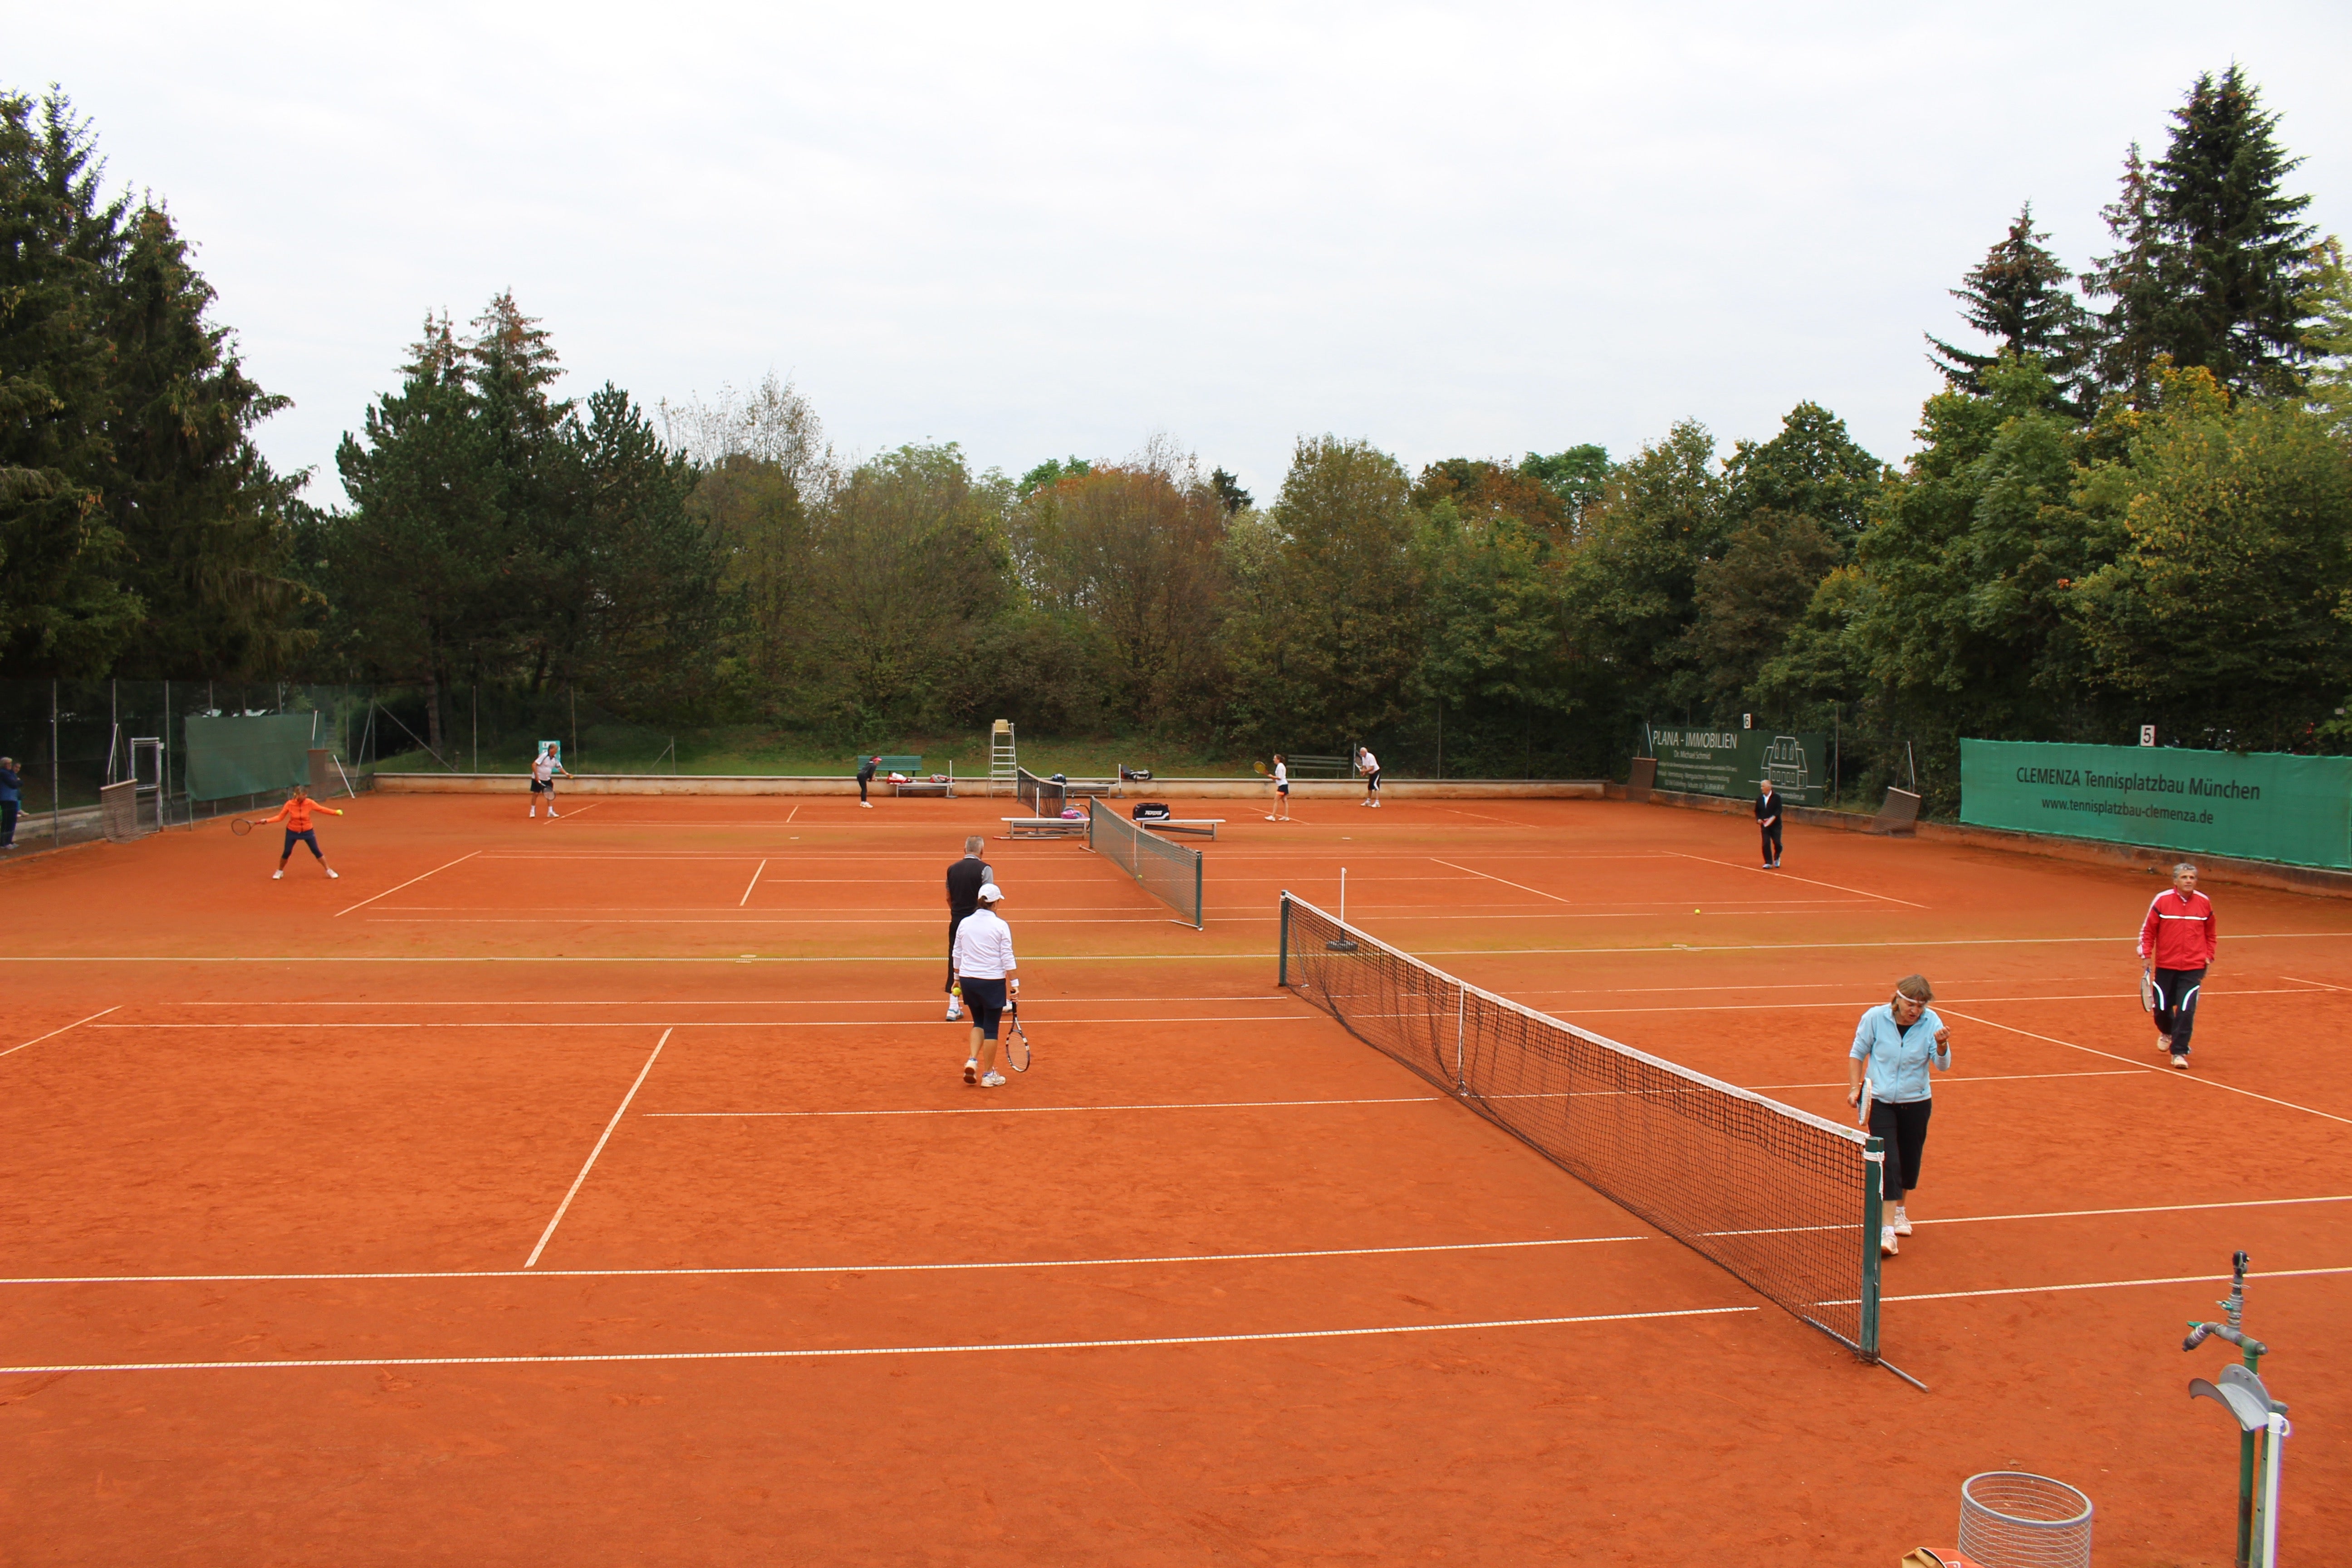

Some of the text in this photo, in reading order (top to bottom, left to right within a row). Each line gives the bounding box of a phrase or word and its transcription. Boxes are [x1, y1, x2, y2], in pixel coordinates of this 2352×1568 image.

[1744, 715, 1750, 727] 6
[1652, 730, 1679, 746] PLANA
[1686, 732, 1737, 749] IMMOBILIEN
[2143, 727, 2151, 743] 5
[1680, 750, 1696, 759] Michael
[1695, 751, 1711, 760] Schmid
[2017, 767, 2260, 799] CLEMENZA Tennisplatzbau München
[2042, 799, 2214, 824] www.tennisplatzbau-clemenza.de
